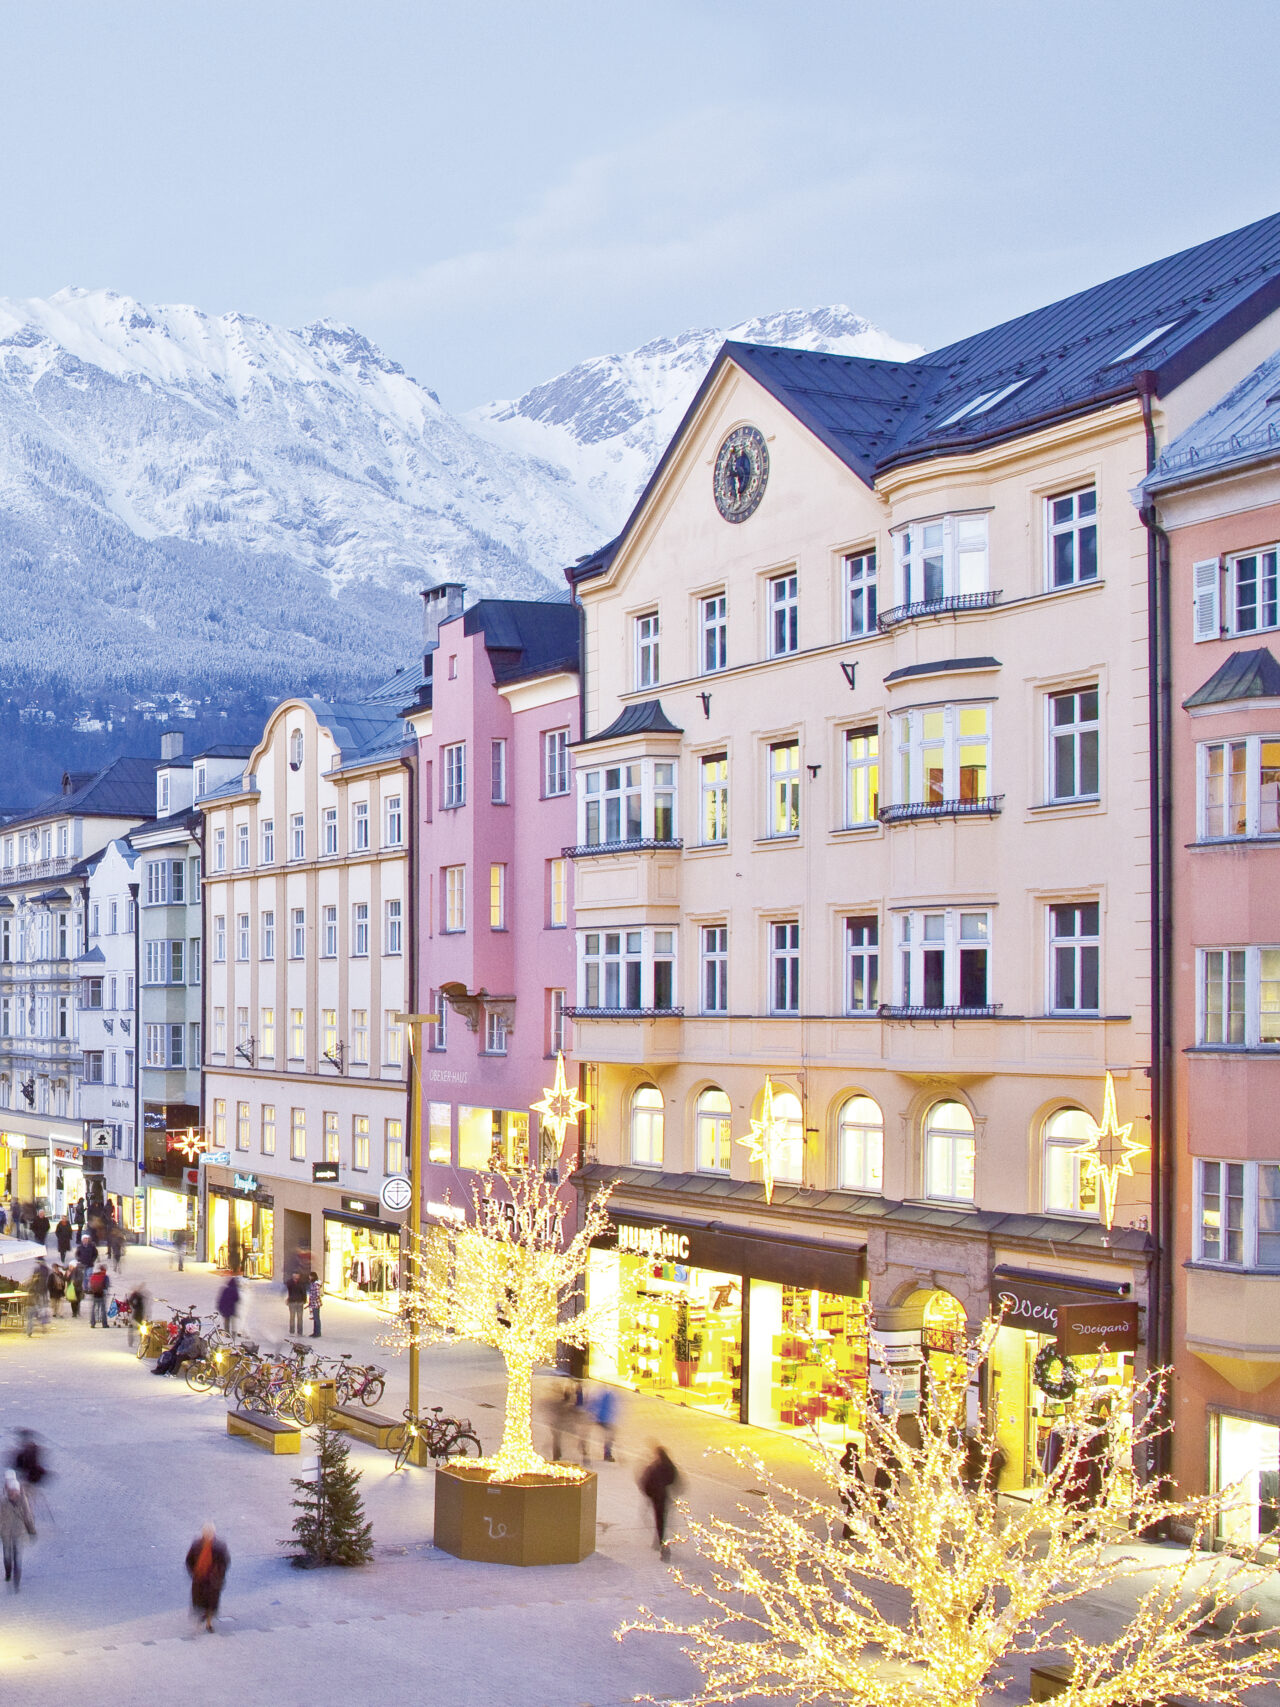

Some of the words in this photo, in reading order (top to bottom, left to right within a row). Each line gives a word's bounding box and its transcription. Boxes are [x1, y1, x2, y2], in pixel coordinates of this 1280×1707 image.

[618, 1224, 690, 1260] HUMANIC
[998, 1291, 1058, 1329] Weig
[1071, 1320, 1129, 1337] Weigand
